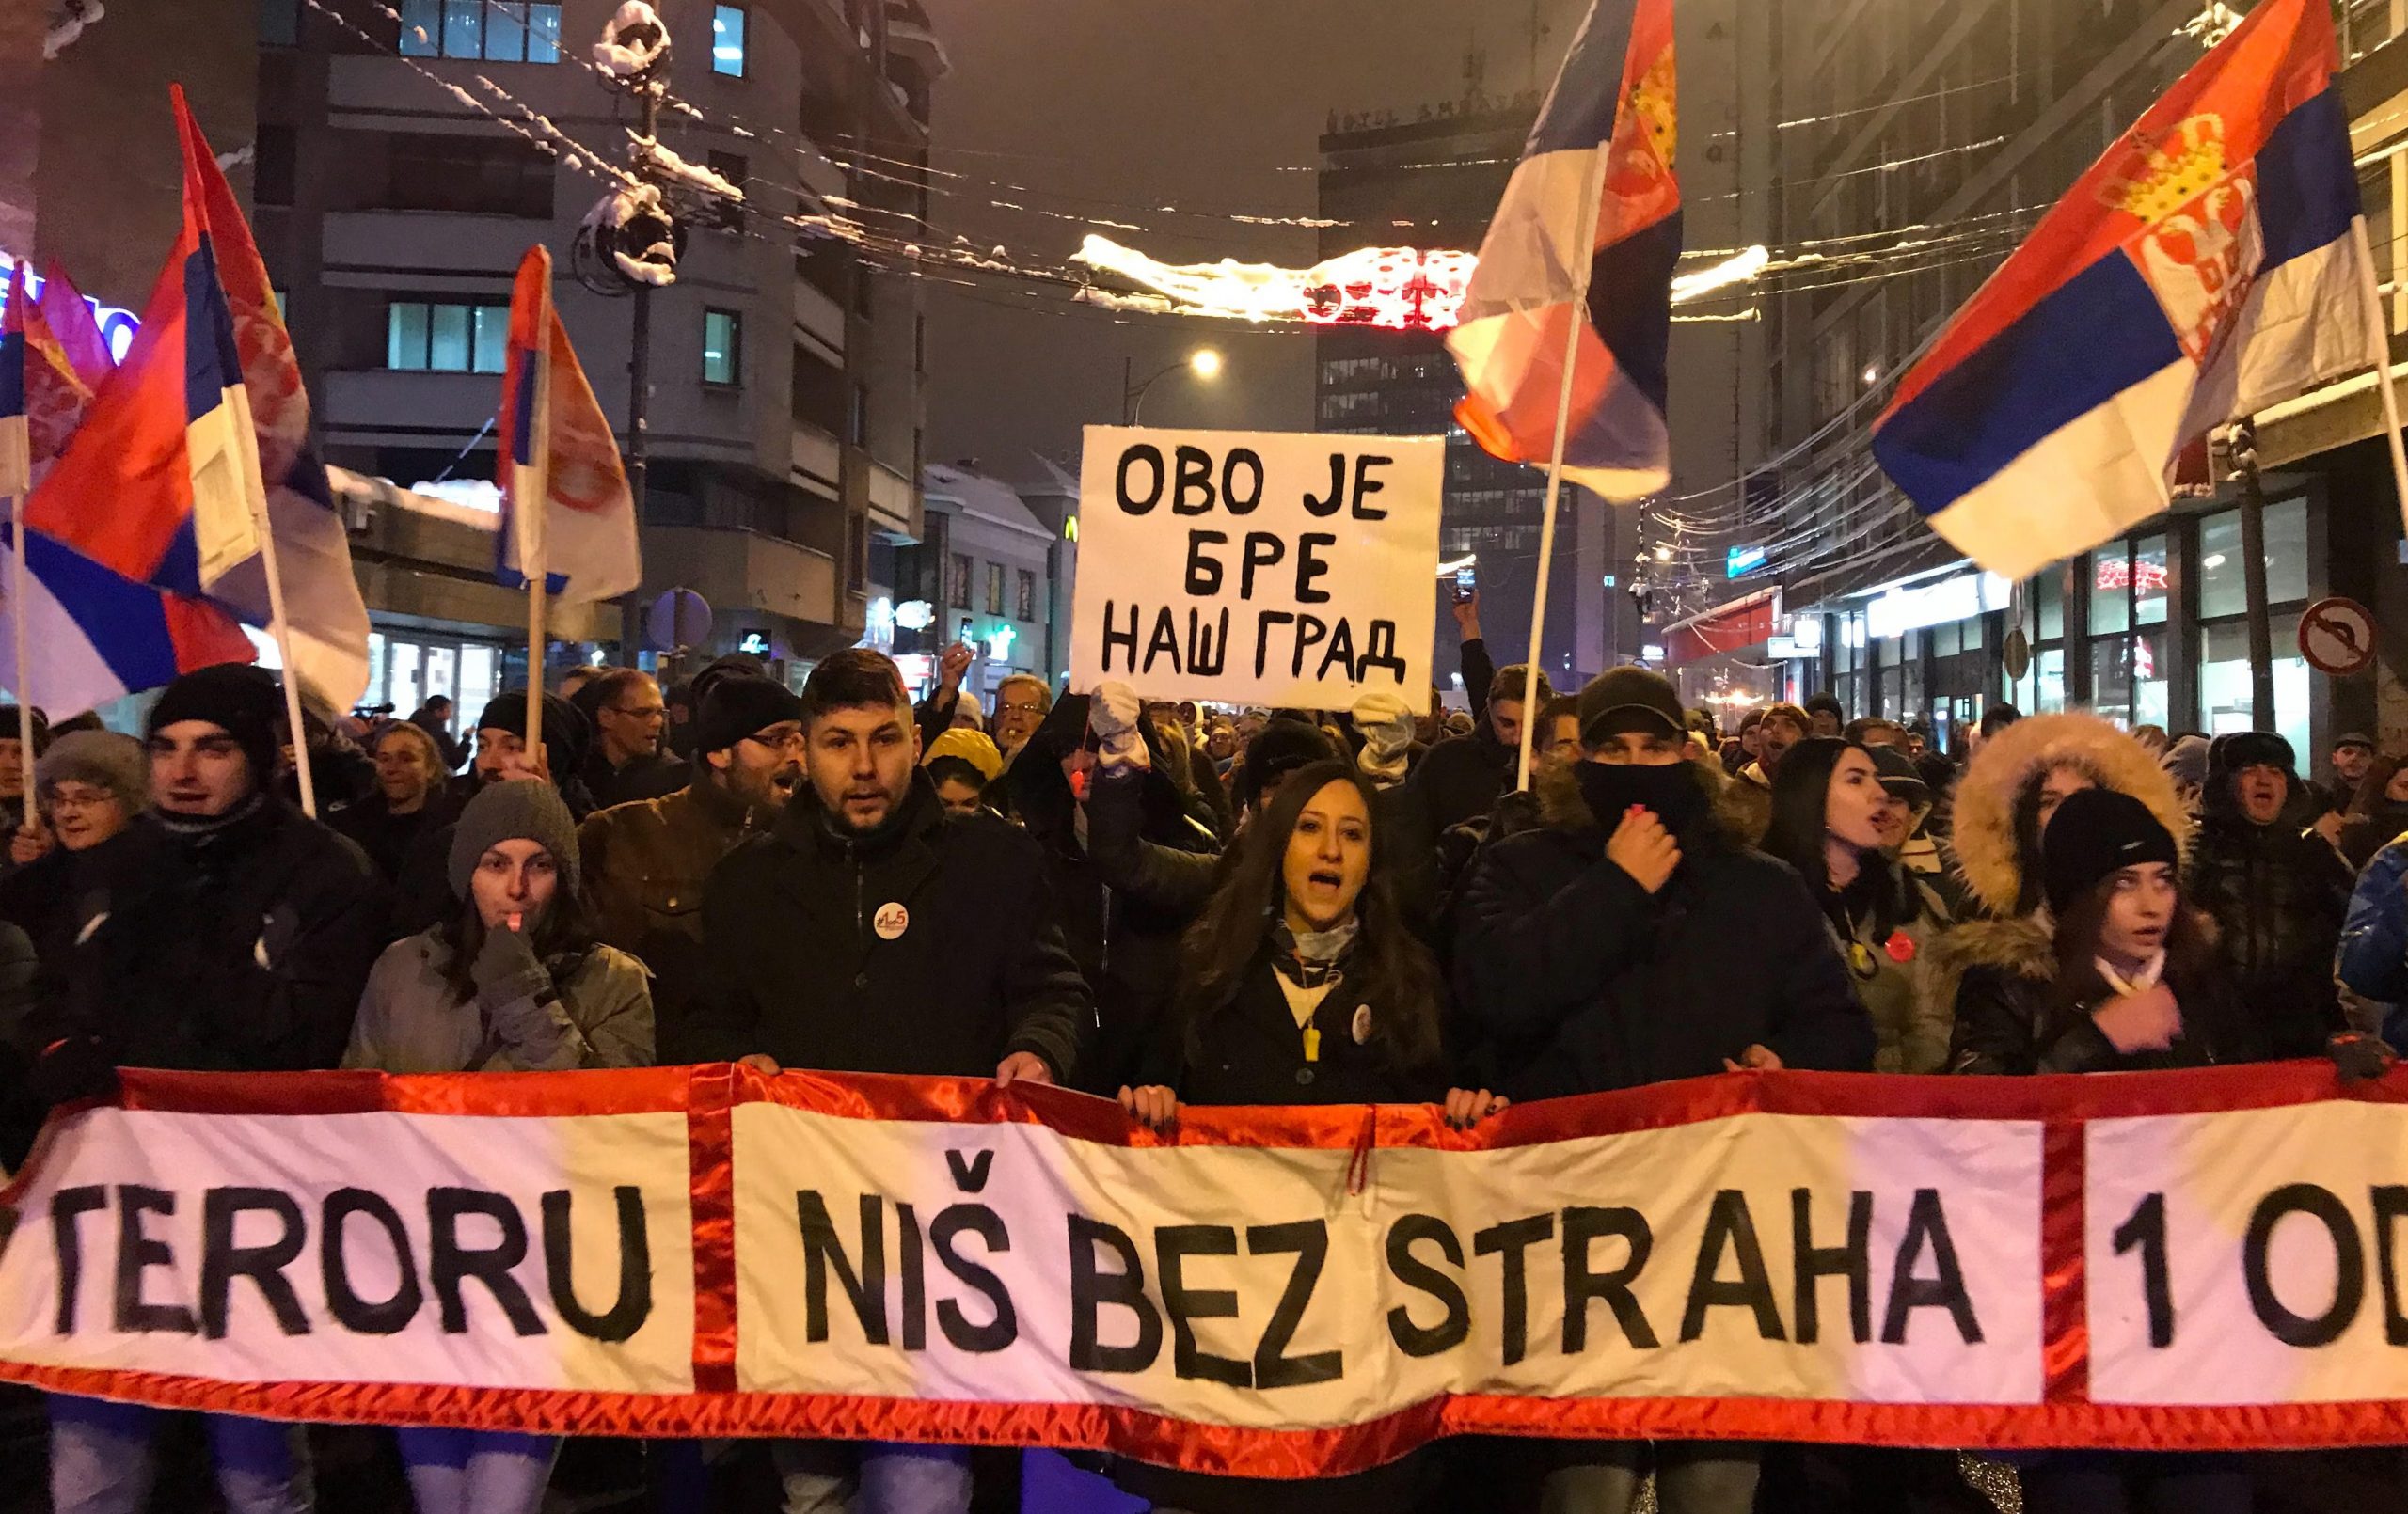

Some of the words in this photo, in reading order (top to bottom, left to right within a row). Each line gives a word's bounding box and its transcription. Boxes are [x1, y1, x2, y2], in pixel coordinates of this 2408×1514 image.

[1116, 443, 1264, 516] ОВО
[1303, 453, 1394, 520] ЈЕ
[1184, 528, 1337, 604] БРЕ
[1101, 600, 1229, 675] НАШ
[1255, 609, 1406, 685] ГРАД
[51, 1183, 655, 1342] TERORU
[796, 1149, 1019, 1355] NIŠ
[1067, 1212, 1344, 1390] BEZ
[1385, 1187, 1986, 1367] STRAHA
[2113, 1191, 2174, 1349] 1
